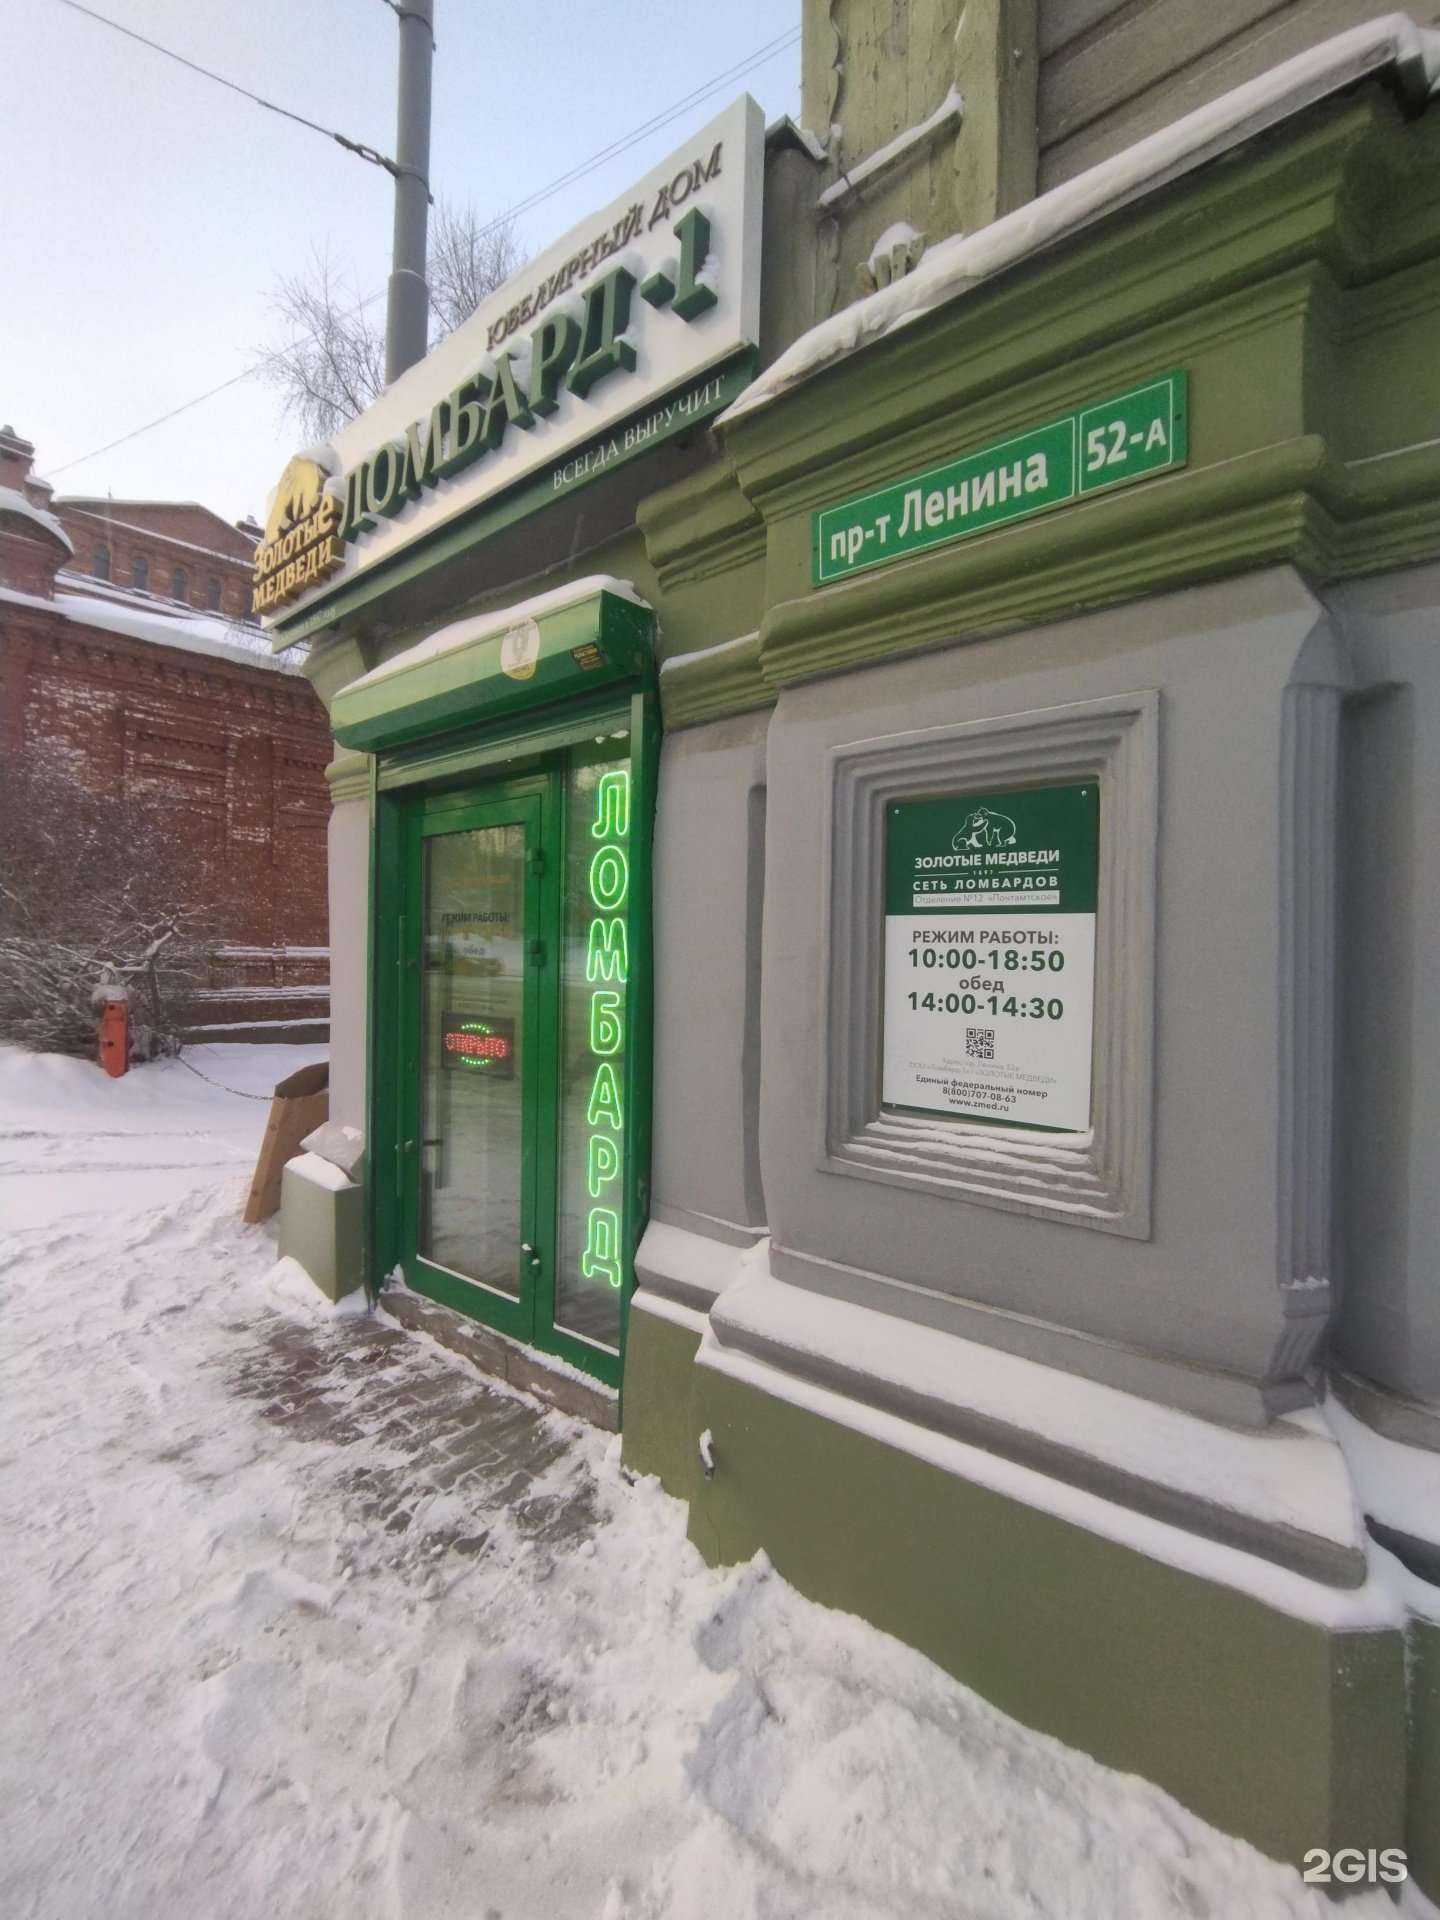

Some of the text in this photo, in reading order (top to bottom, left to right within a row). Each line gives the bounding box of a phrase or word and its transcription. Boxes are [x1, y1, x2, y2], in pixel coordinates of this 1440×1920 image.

[486, 141, 723, 351] ЮВЕЛИРНЫЙ ДОМ
[552, 375, 725, 490] ВСЕГДА ВЫРУЧИТ
[1087, 418, 1167, 472] 52-А
[830, 452, 1048, 563] пр-т Ленина
[252, 536, 333, 613] МЕДВЕДИ
[914, 849, 1060, 869] ЗОЛОТЫЕ МЕДВЕДИ
[912, 876, 1058, 891] СЕТЬ ЛОМБАРДОВ
[912, 931, 1059, 944] РЕЖИМ РАБОТЫ:
[908, 949, 1065, 972] 10:00-18:50
[959, 975, 1004, 993] обед
[908, 992, 1064, 1020] 14:00-14:30
[582, 770, 630, 1288] ЛОМБАРД
[915, 1074, 1048, 1099] Единый федеральный номер
[949, 1098, 1009, 1112] www.zmed.ru
